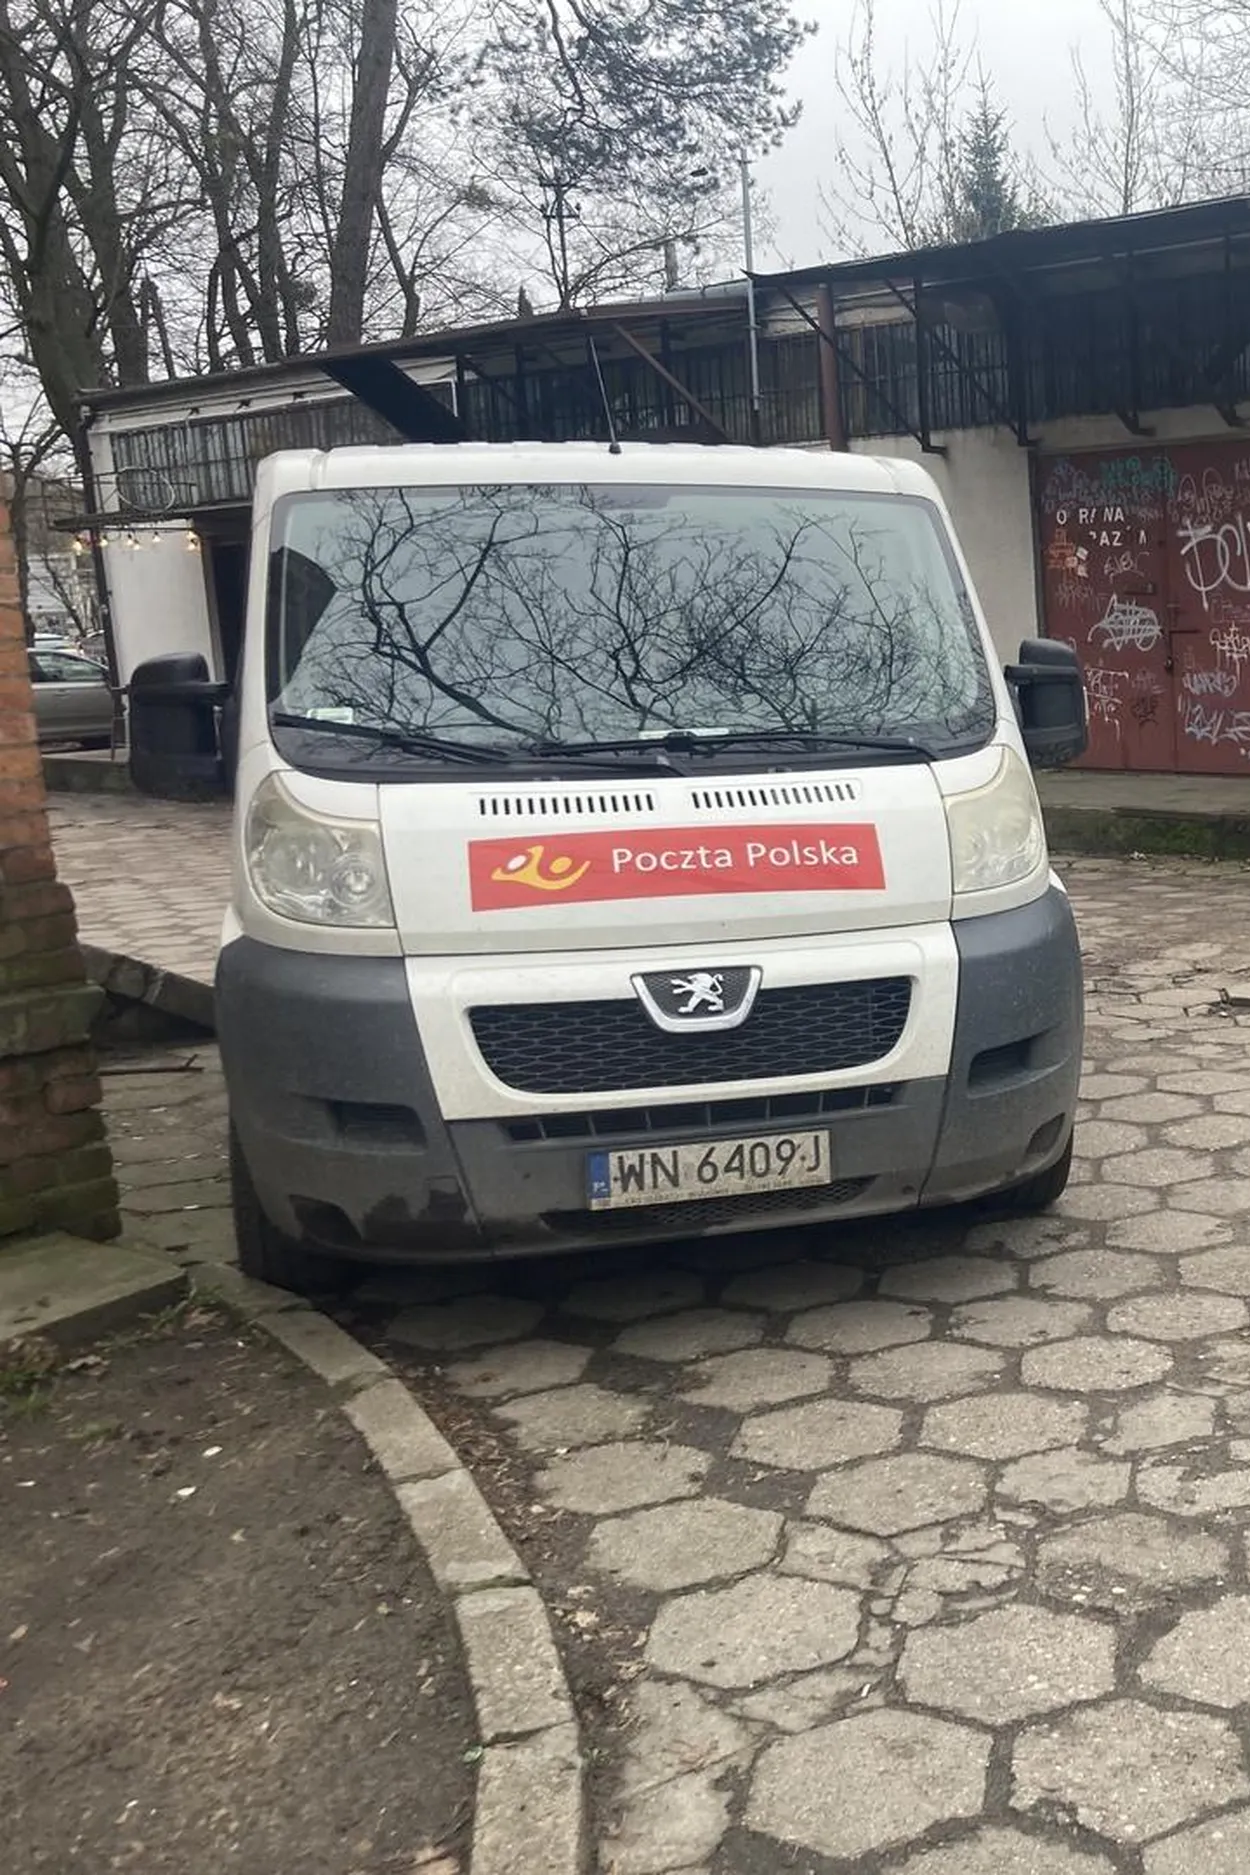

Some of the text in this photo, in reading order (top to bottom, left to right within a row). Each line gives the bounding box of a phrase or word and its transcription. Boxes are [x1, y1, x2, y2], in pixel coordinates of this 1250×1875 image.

[612, 840, 859, 873] Poczta Polska
[617, 1134, 820, 1193] WN 6409J
